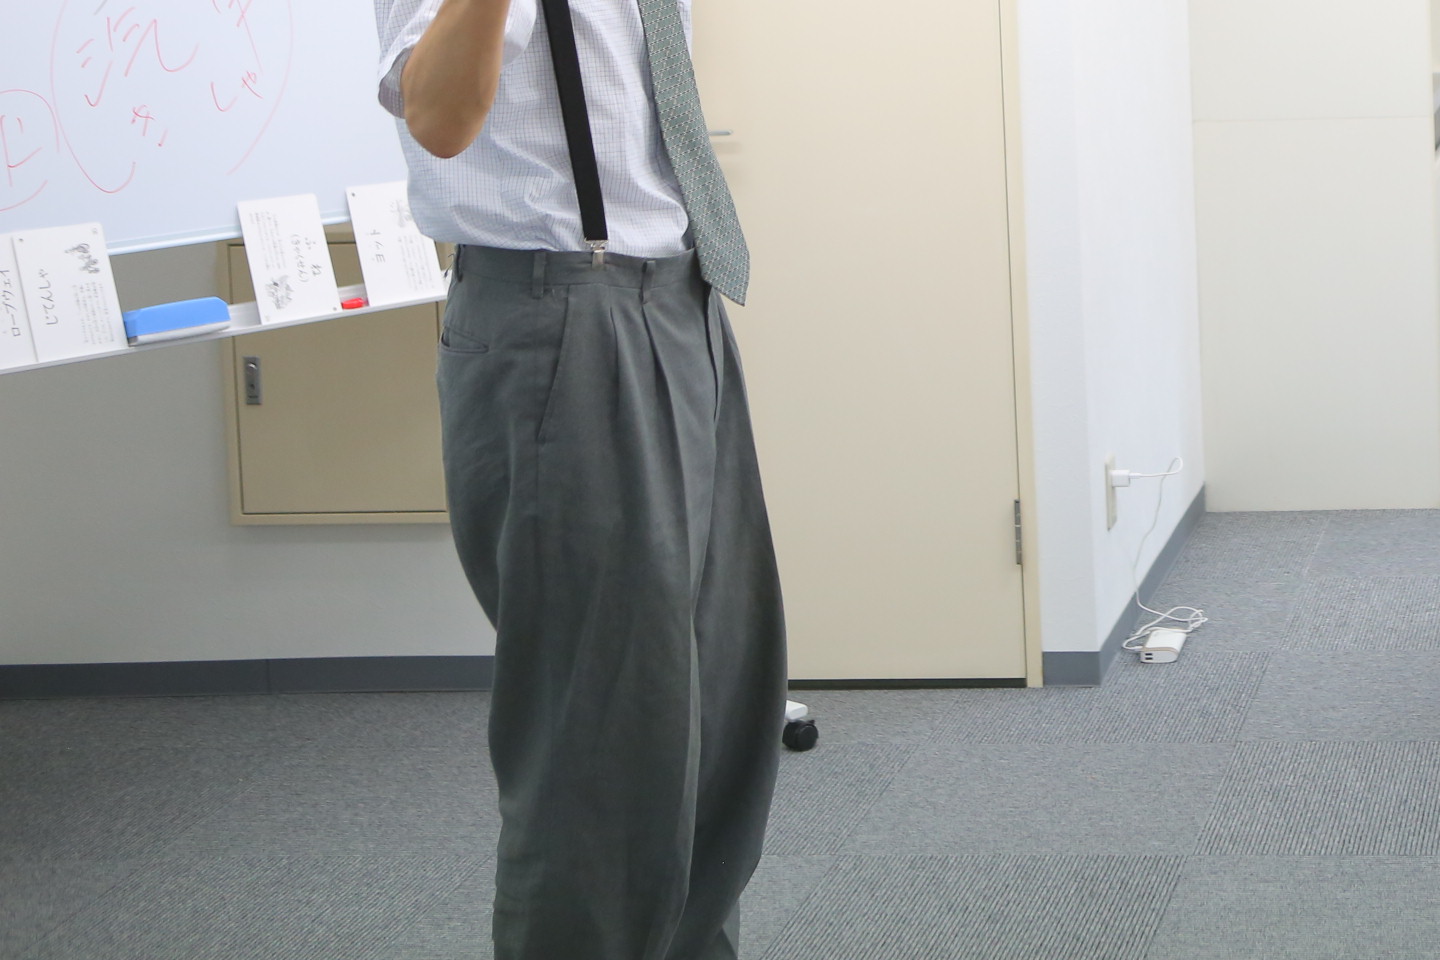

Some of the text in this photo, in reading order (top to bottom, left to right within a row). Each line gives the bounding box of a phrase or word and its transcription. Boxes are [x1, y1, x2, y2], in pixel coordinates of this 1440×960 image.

[37, 268, 59, 326] じてんしゃ
